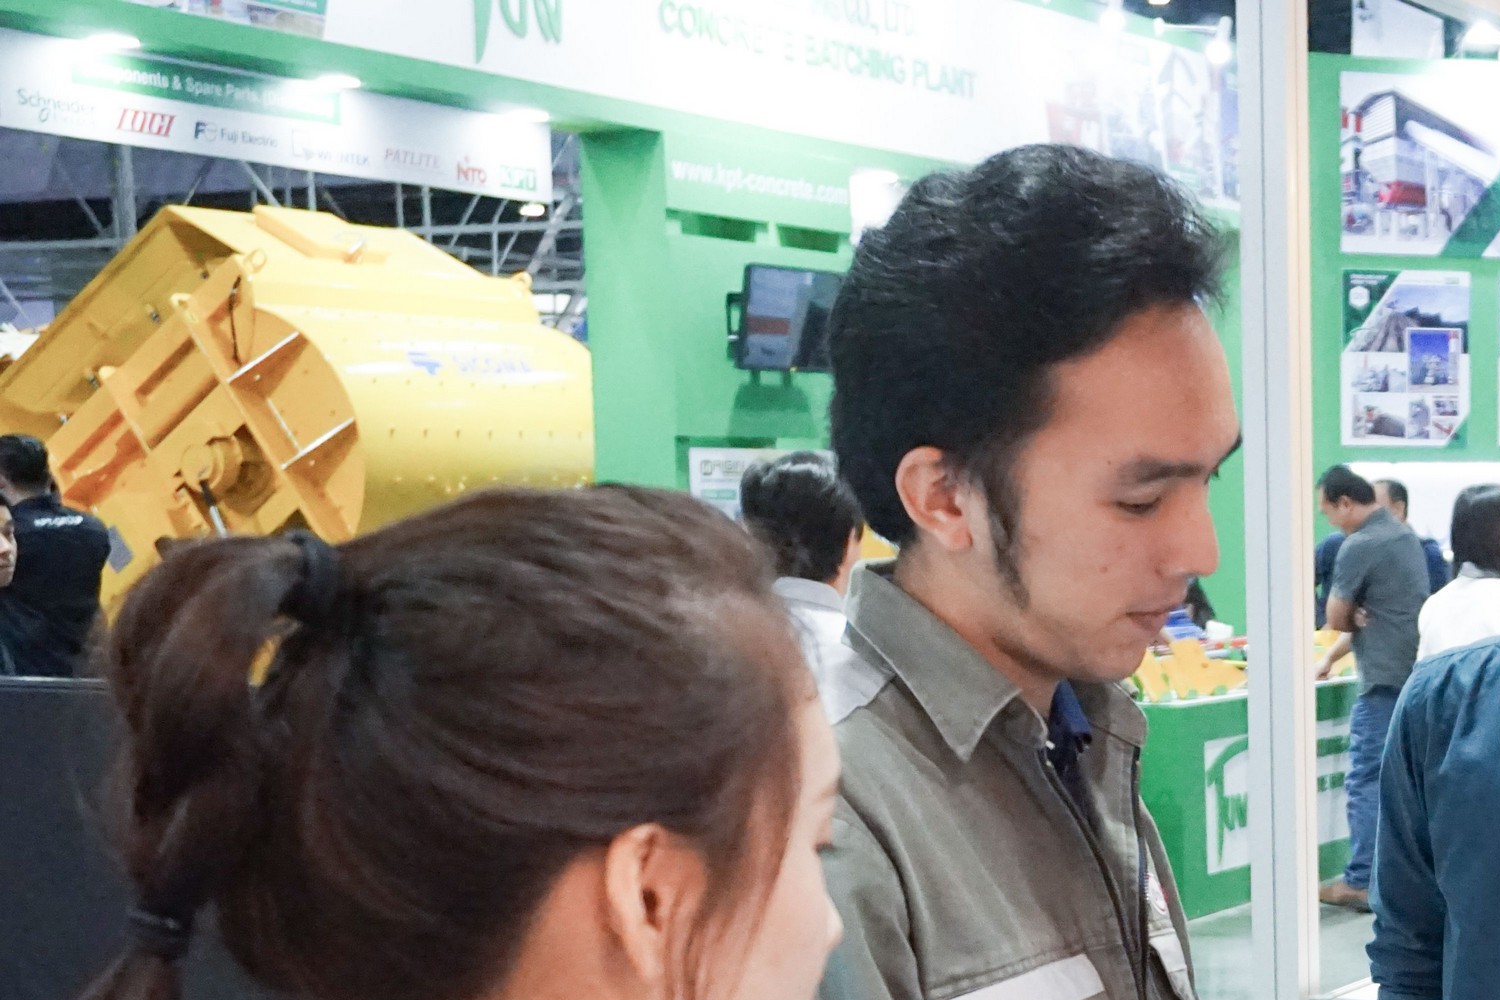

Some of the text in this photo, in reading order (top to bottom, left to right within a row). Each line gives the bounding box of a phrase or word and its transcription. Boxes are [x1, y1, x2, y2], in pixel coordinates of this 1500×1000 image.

[172, 75, 182, 91] &
[803, 33, 906, 85] BATCHING
[911, 58, 977, 100] PLANT
